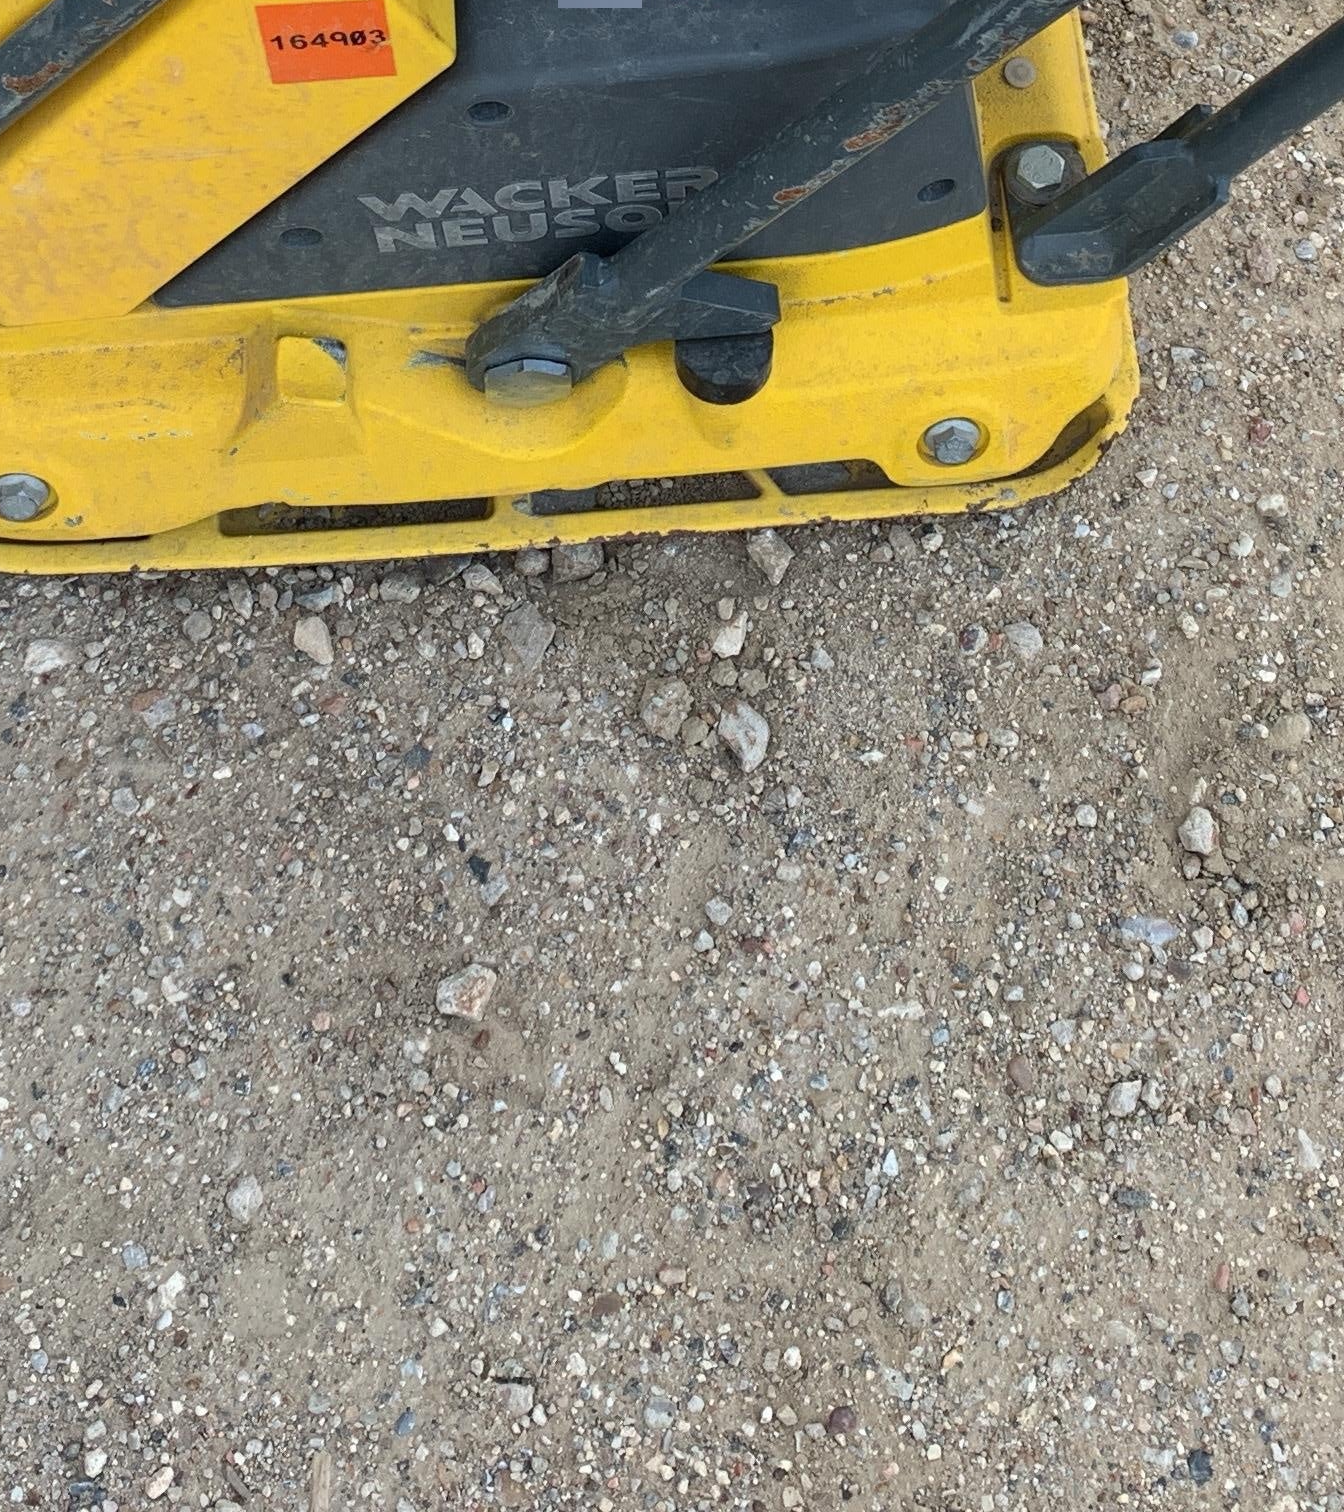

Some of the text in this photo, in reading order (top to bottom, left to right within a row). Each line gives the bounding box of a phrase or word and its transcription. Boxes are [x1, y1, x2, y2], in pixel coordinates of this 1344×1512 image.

[269, 29, 386, 51] 164903
[357, 167, 719, 222] WACKER
[373, 204, 663, 253] NEUSO
